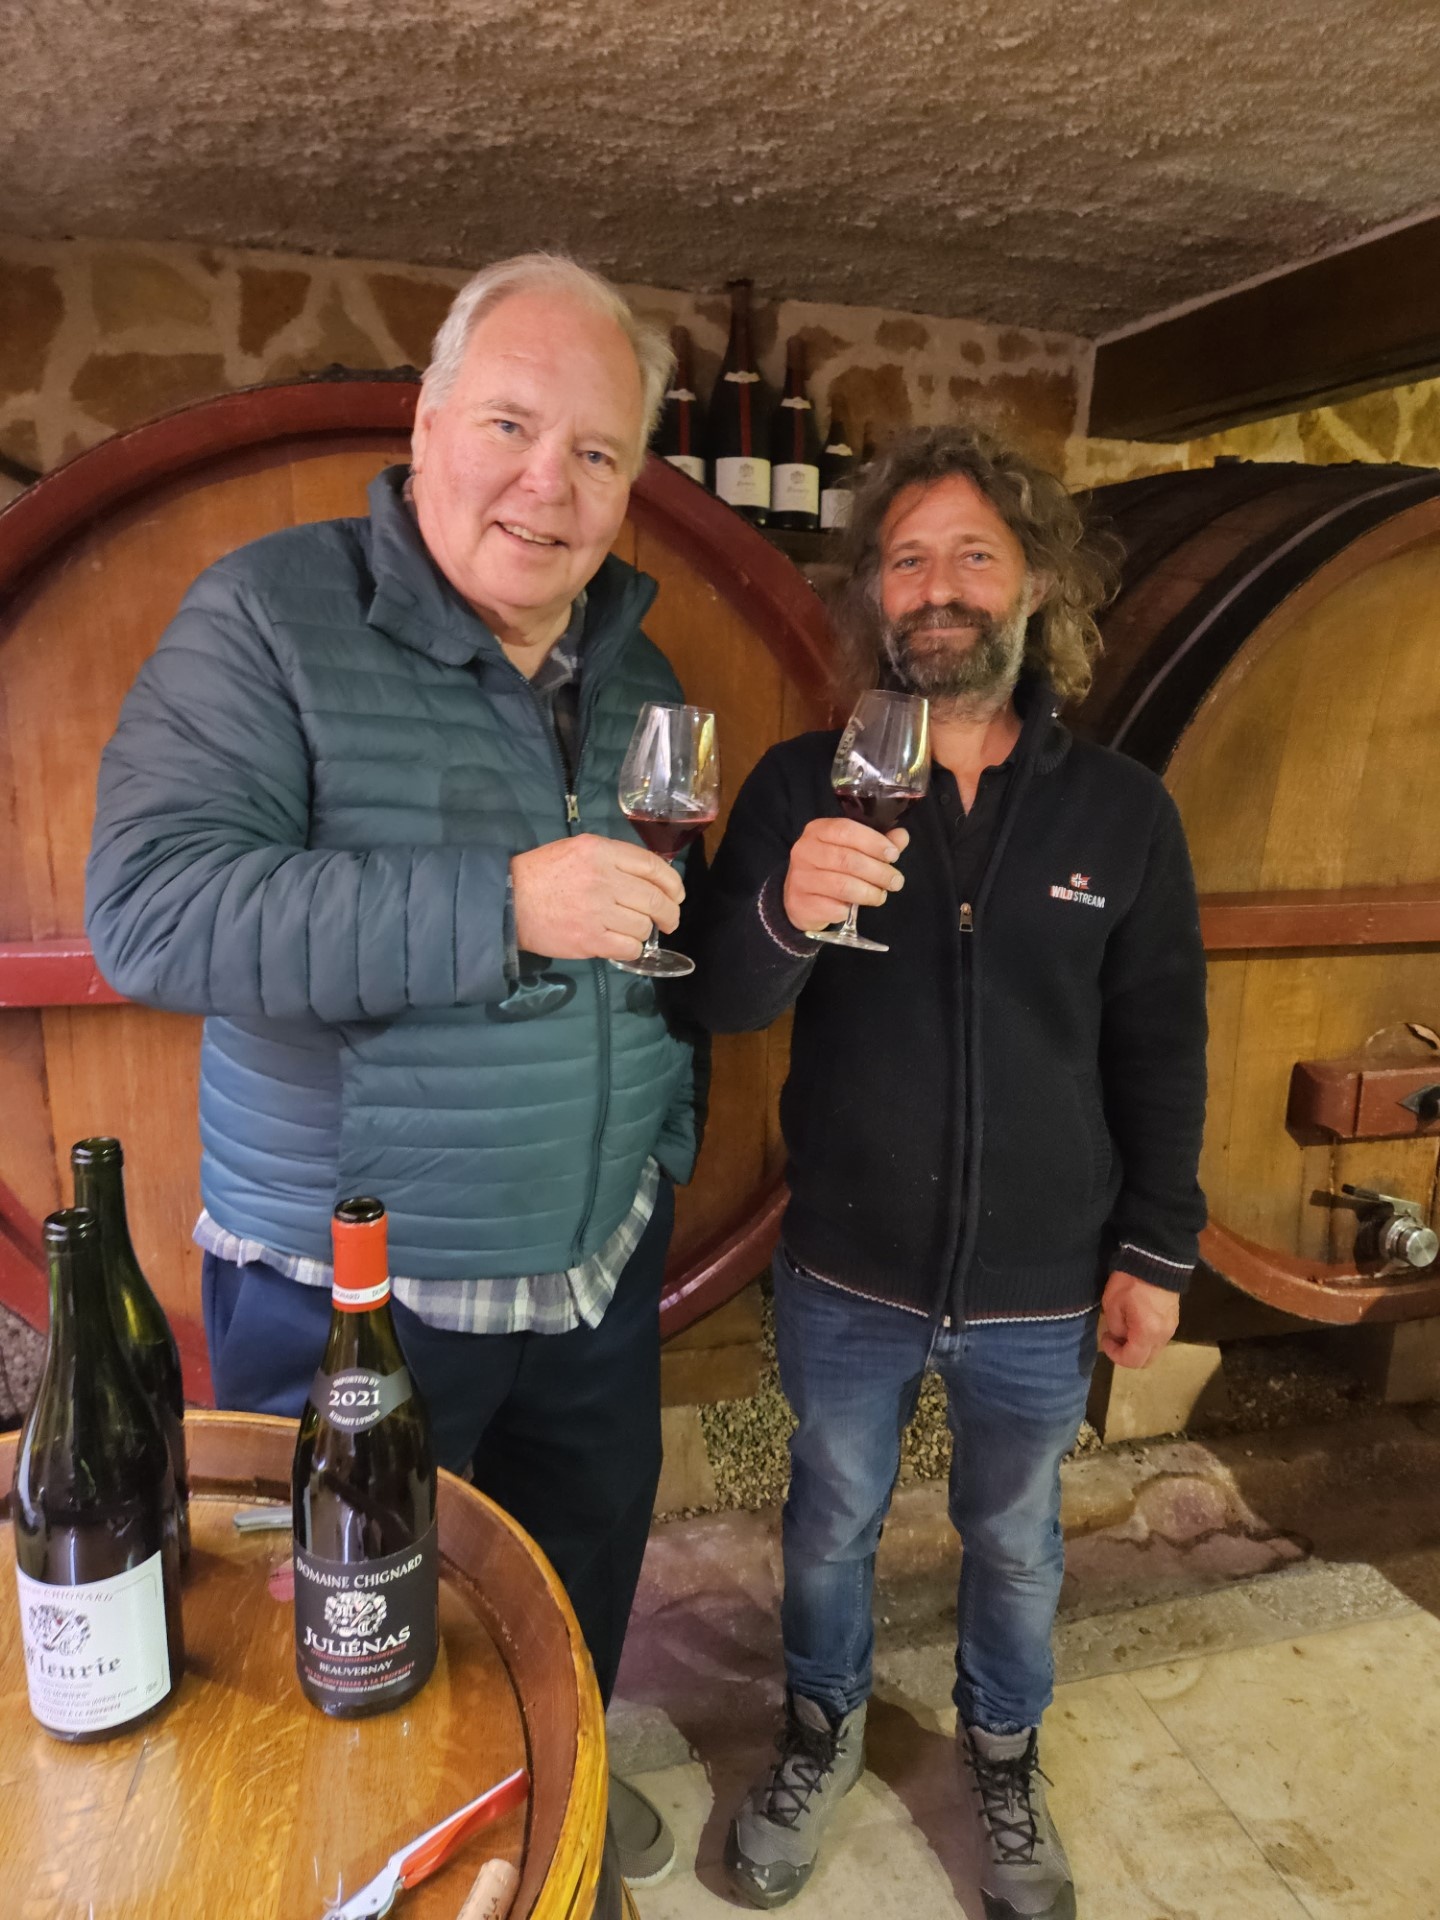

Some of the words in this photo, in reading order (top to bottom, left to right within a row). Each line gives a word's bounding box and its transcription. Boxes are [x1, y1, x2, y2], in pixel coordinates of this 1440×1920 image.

[333, 1375, 369, 1388] IMPORTED
[369, 1376, 380, 1387] BY
[328, 1389, 381, 1407] 2021
[296, 1556, 350, 1589] DOMAINE
[354, 1554, 422, 1589] CHIGNARD
[304, 1625, 411, 1657] JULIÉNAS
[320, 1659, 393, 1677] BEAUVERNAY
